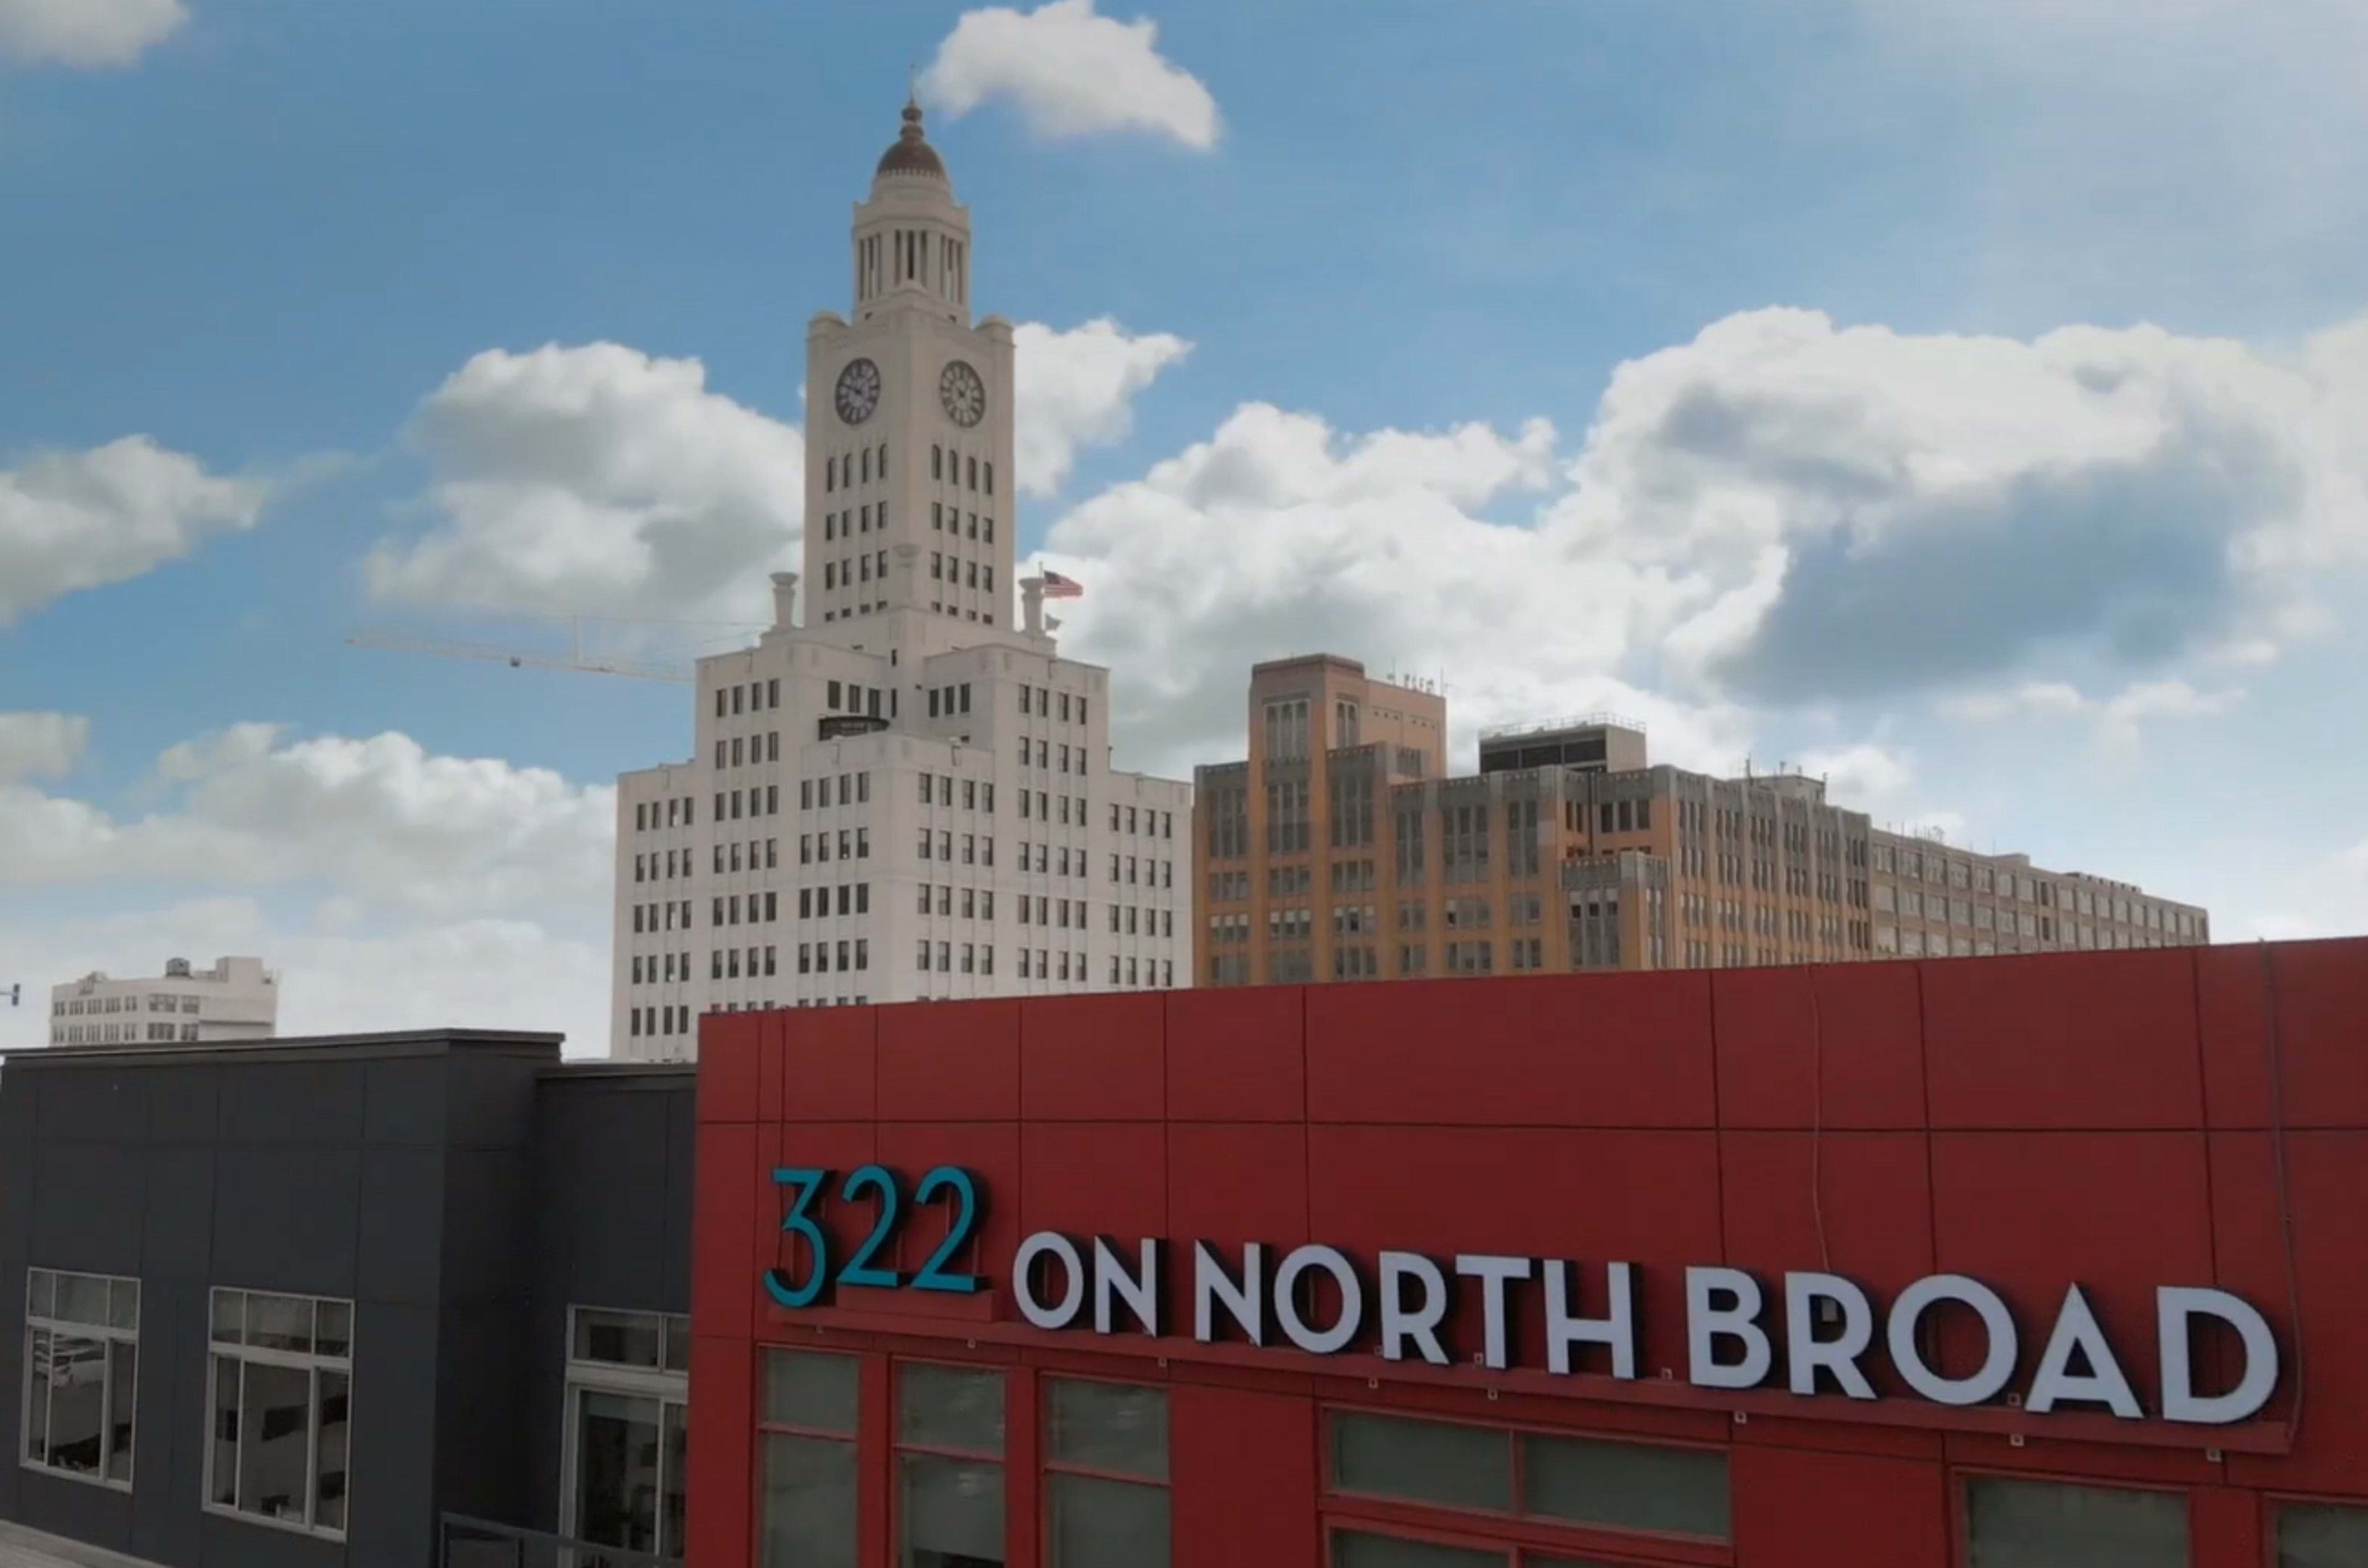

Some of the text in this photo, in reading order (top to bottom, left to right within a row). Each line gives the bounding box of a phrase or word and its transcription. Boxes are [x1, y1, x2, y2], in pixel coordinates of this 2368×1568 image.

[763, 1165, 2279, 1424] 322 ON NORTH BROAD
